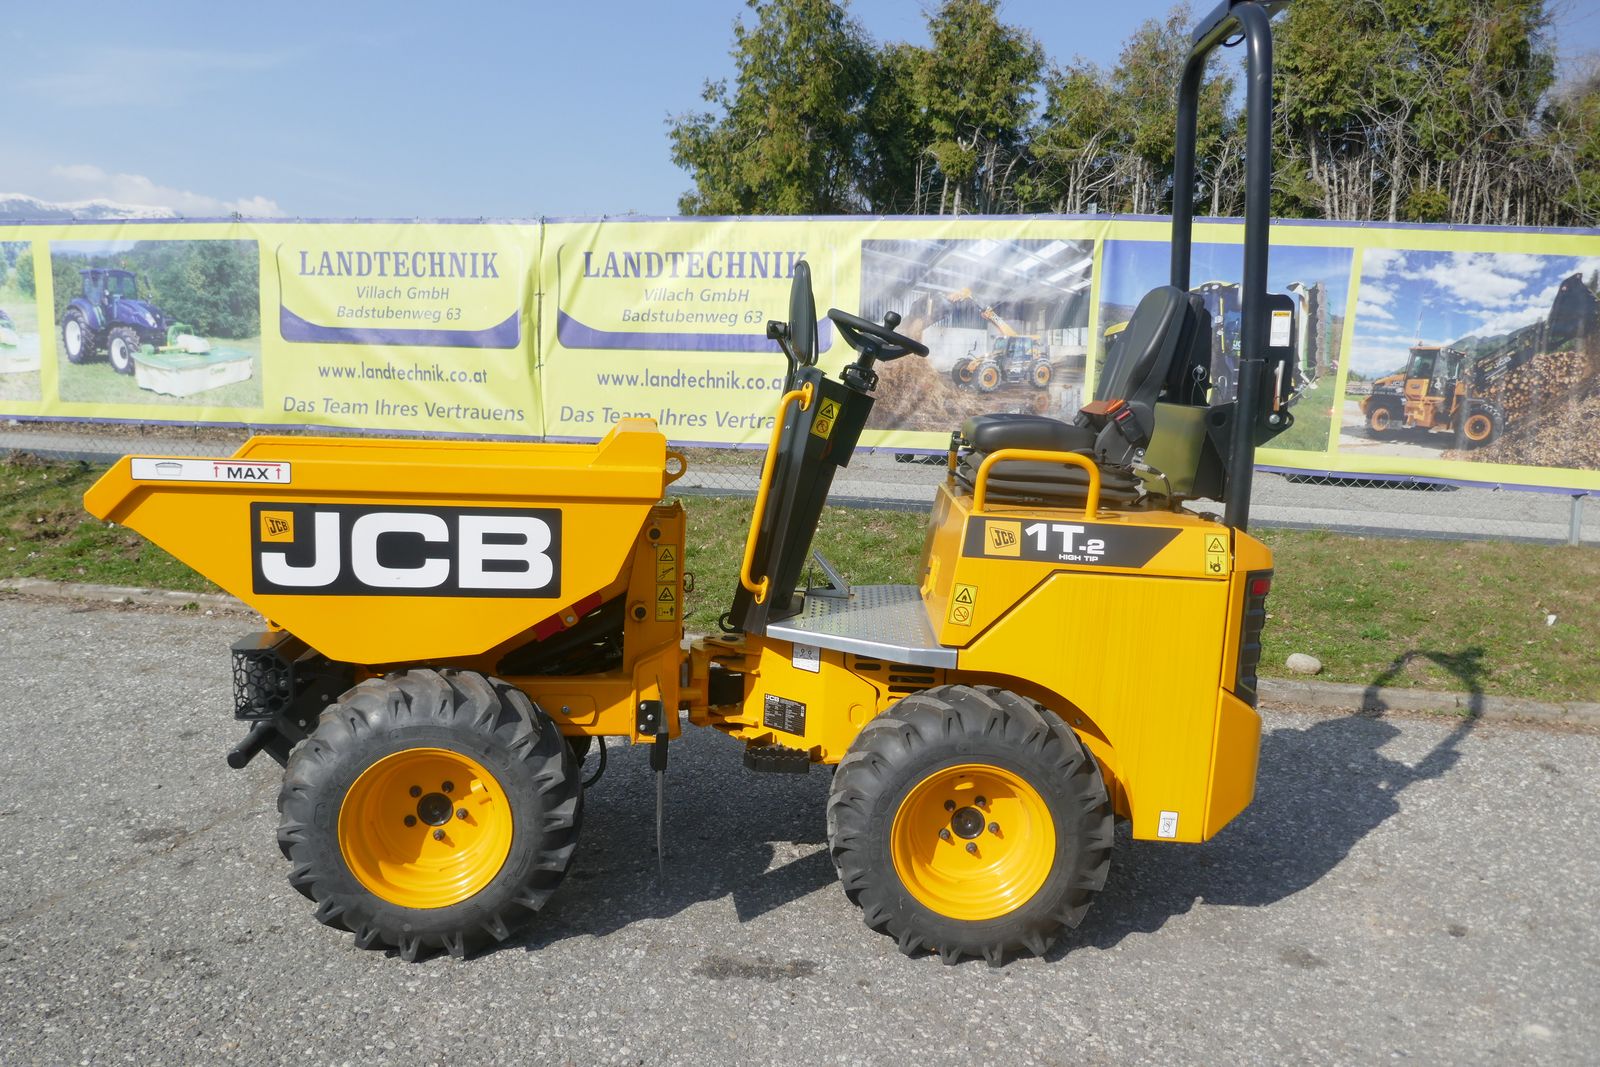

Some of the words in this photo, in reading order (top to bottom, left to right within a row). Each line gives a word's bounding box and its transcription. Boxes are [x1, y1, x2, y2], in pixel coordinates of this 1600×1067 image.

[299, 251, 499, 278] LANDTECHNIK
[583, 251, 807, 279] LANDTECHNIK
[356, 286, 402, 299] Villach
[407, 287, 449, 300] GmbH
[644, 288, 694, 302] Villach
[700, 288, 749, 302] GmbH
[337, 306, 441, 323] Badstubenweg
[446, 308, 462, 321] 63
[622, 309, 738, 326] Badstubenweg
[744, 310, 763, 324] 63
[318, 361, 488, 384] www.landtechnik.co.at
[283, 397, 315, 413] Das
[322, 397, 368, 415] Team
[375, 399, 418, 417] Ihres
[424, 402, 525, 421] Vertrauens
[560, 406, 594, 423] Das
[658, 409, 707, 427] Ihres
[715, 410, 776, 429] Vertra
[227, 467, 269, 480] MAX
[269, 518, 289, 535] JCB
[994, 529, 1015, 547] JCB
[261, 511, 553, 590] JCB
